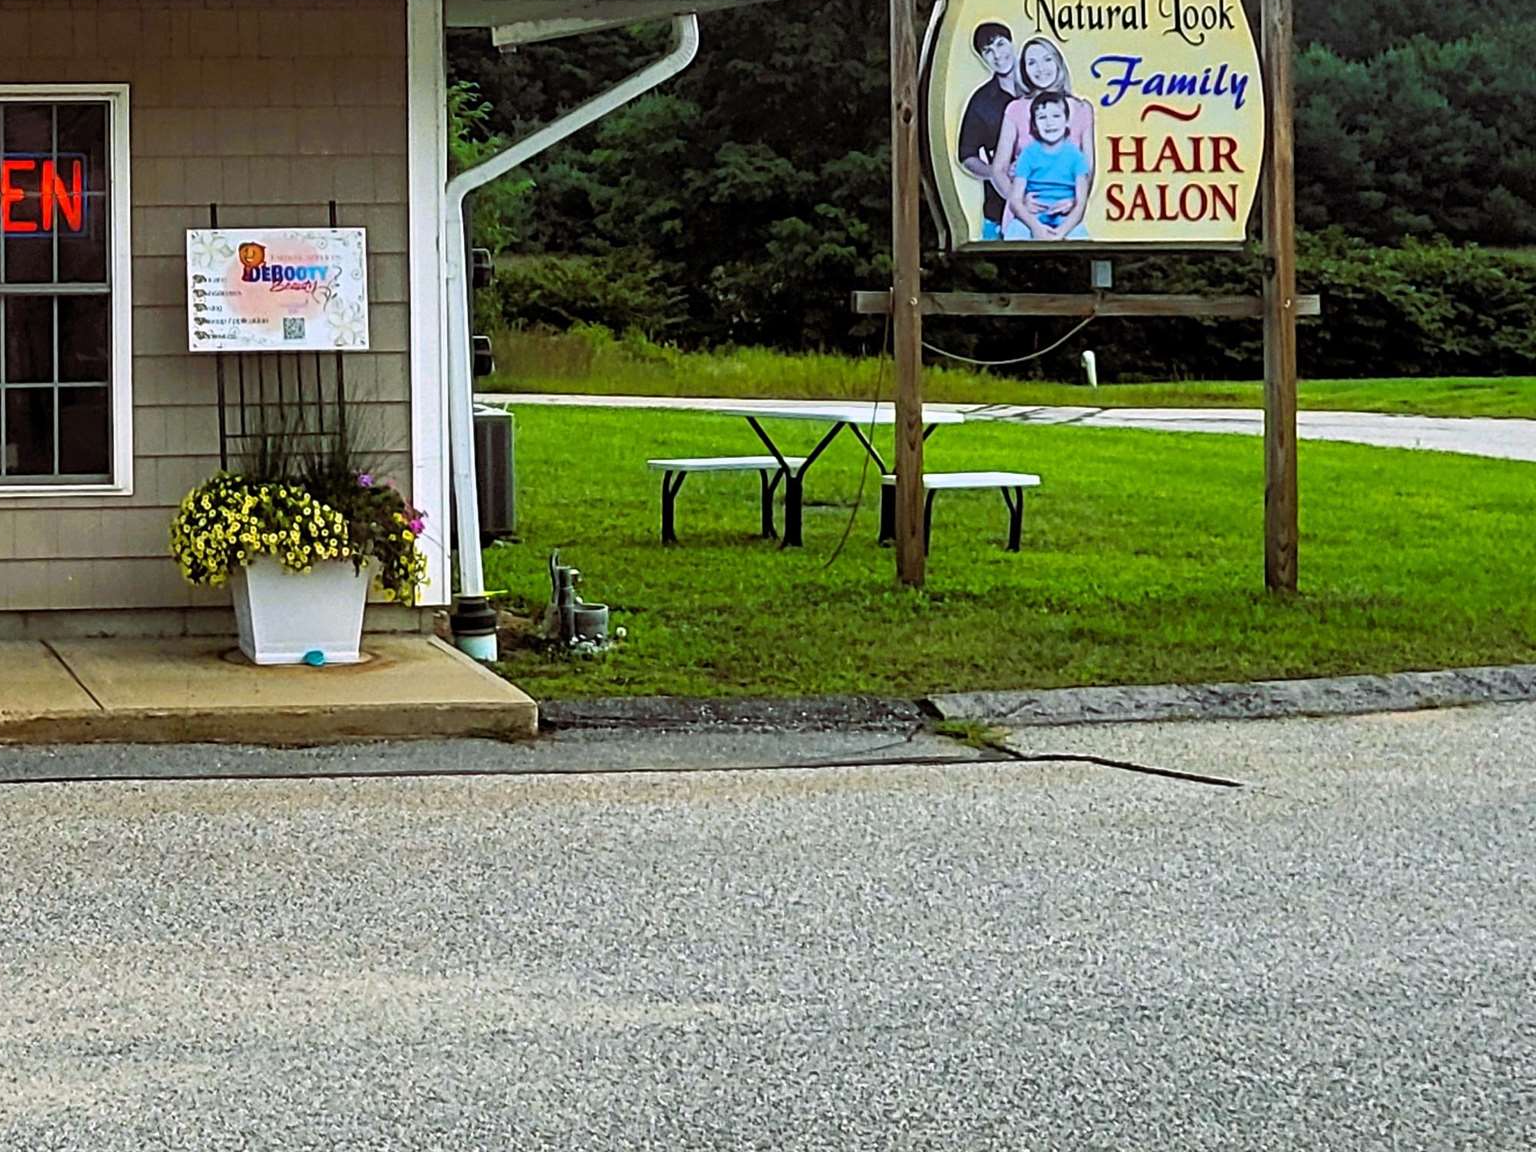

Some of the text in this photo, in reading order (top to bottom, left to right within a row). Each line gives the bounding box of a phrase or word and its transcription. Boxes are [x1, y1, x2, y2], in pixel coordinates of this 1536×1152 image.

[1090, 55, 1249, 109] Family
[1107, 135, 1244, 174] HAIR
[1105, 183, 1238, 222] SALON
